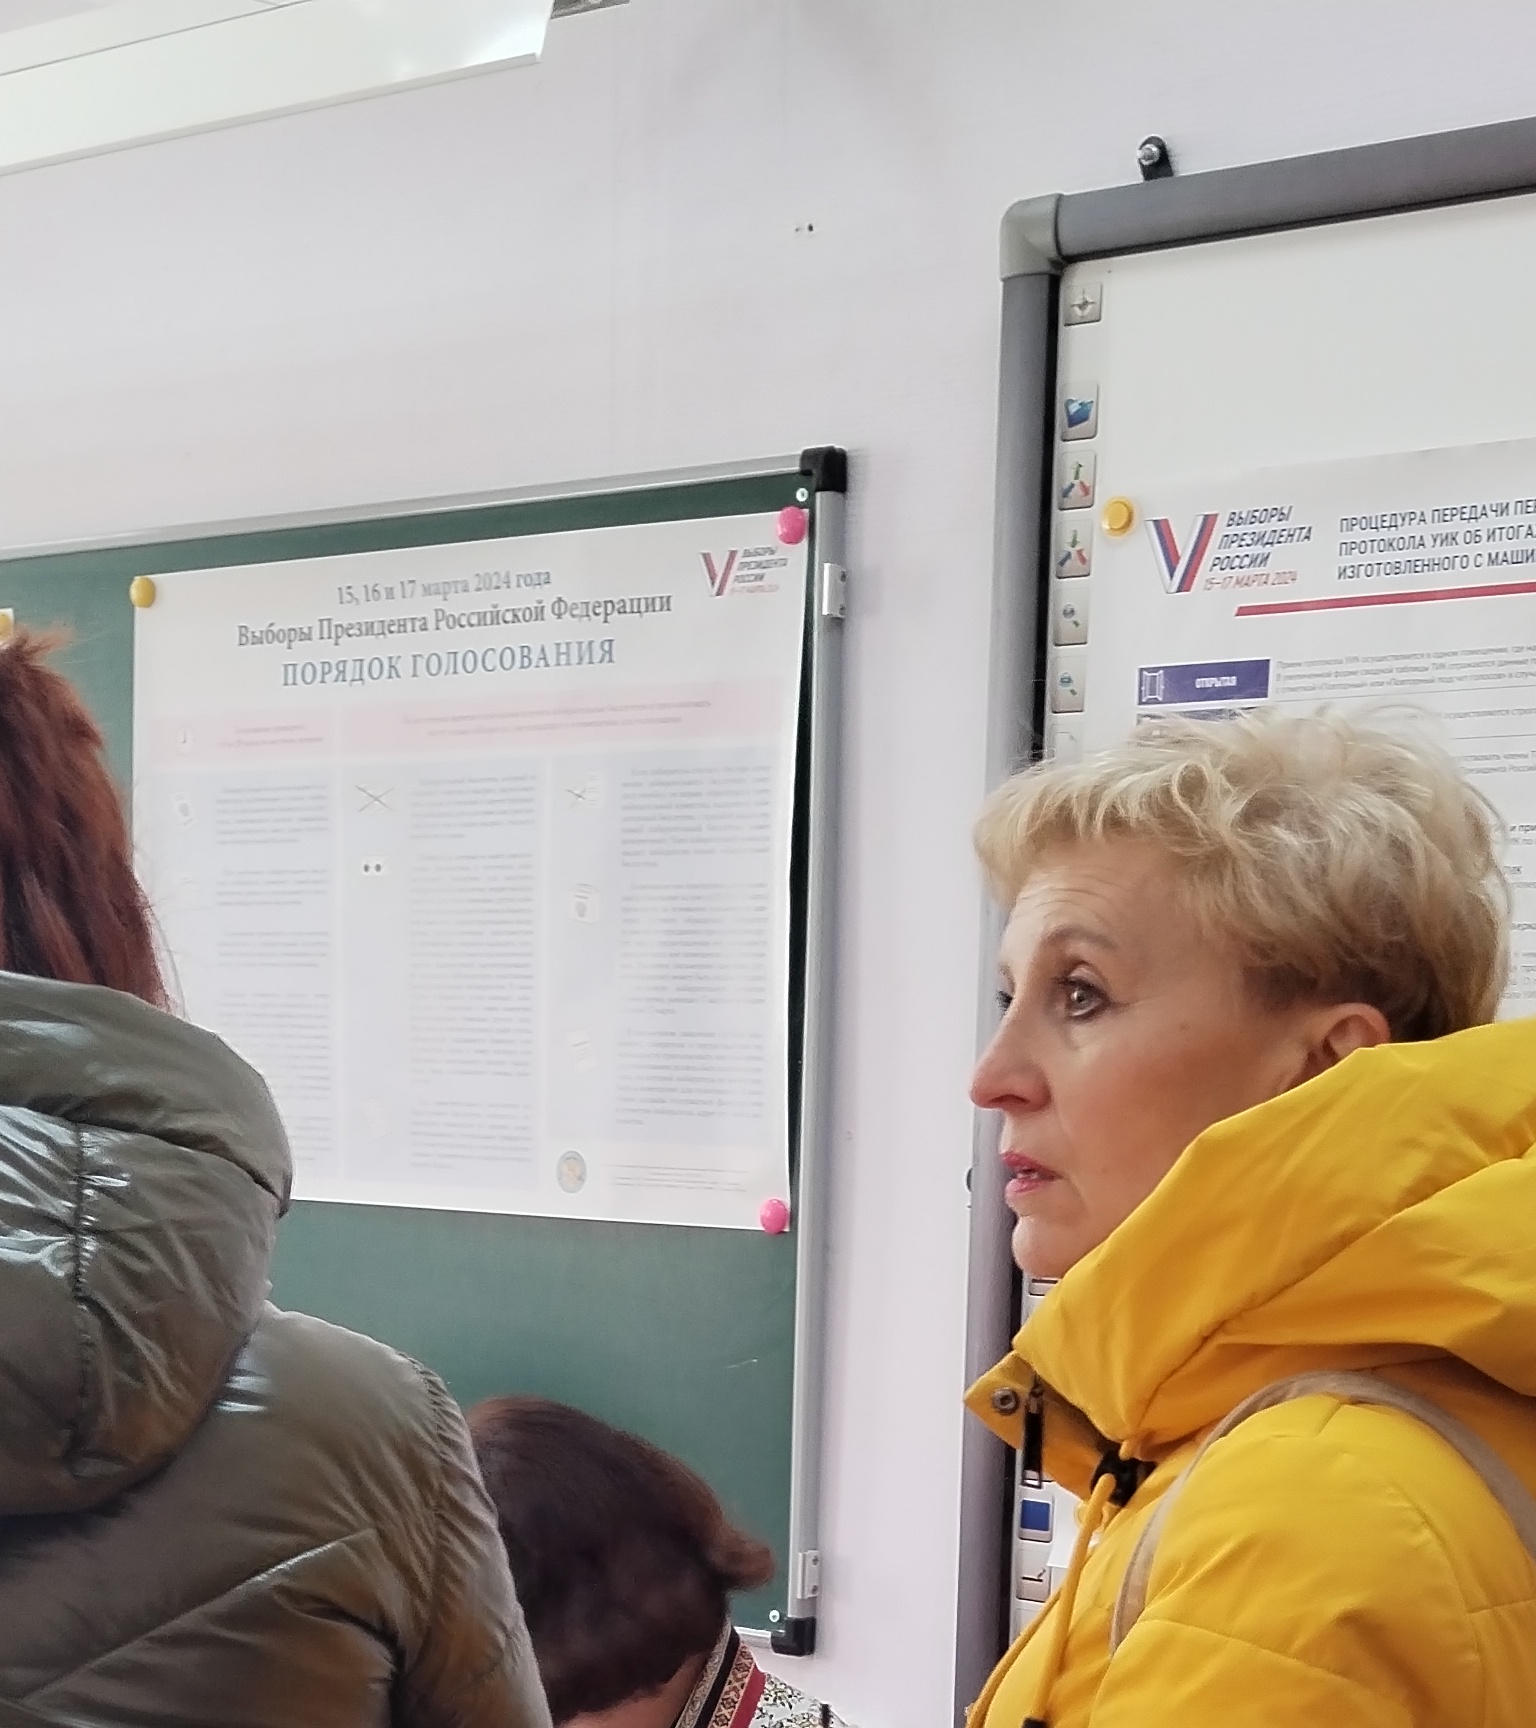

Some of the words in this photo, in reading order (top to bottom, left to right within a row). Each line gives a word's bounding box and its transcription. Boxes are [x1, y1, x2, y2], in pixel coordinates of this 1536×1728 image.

[1226, 506, 1294, 528] ВЫБОРЫ
[1340, 511, 1427, 533] ПРОЦЕДУРА
[1431, 501, 1510, 524] ПЕРЕДАЧИ
[1217, 526, 1313, 550] ПРЕЗИДЕНТА
[1339, 535, 1427, 557] ПРОТОКОЛА
[1430, 531, 1460, 549] УИК
[1463, 529, 1482, 545] ОБ
[1209, 552, 1271, 573] РОССИИ
[1337, 555, 1469, 580] ИЗГОТОВЛЕННОГО
[1474, 553, 1482, 568] С
[337, 585, 360, 605] 15,
[363, 583, 381, 602] 16
[385, 586, 395, 599] и
[400, 579, 417, 598] 17
[421, 578, 469, 601] марта
[474, 571, 511, 592] 2024
[515, 570, 551, 589] года
[1234, 573, 1268, 589] МАРТА
[237, 622, 313, 650] Выборы
[317, 614, 428, 646] Президента
[433, 599, 546, 632] Российской
[551, 594, 672, 624] Федерации
[282, 655, 402, 687] ПОРЯДОК
[411, 638, 616, 678] ГОЛОСОВАНИЯ
